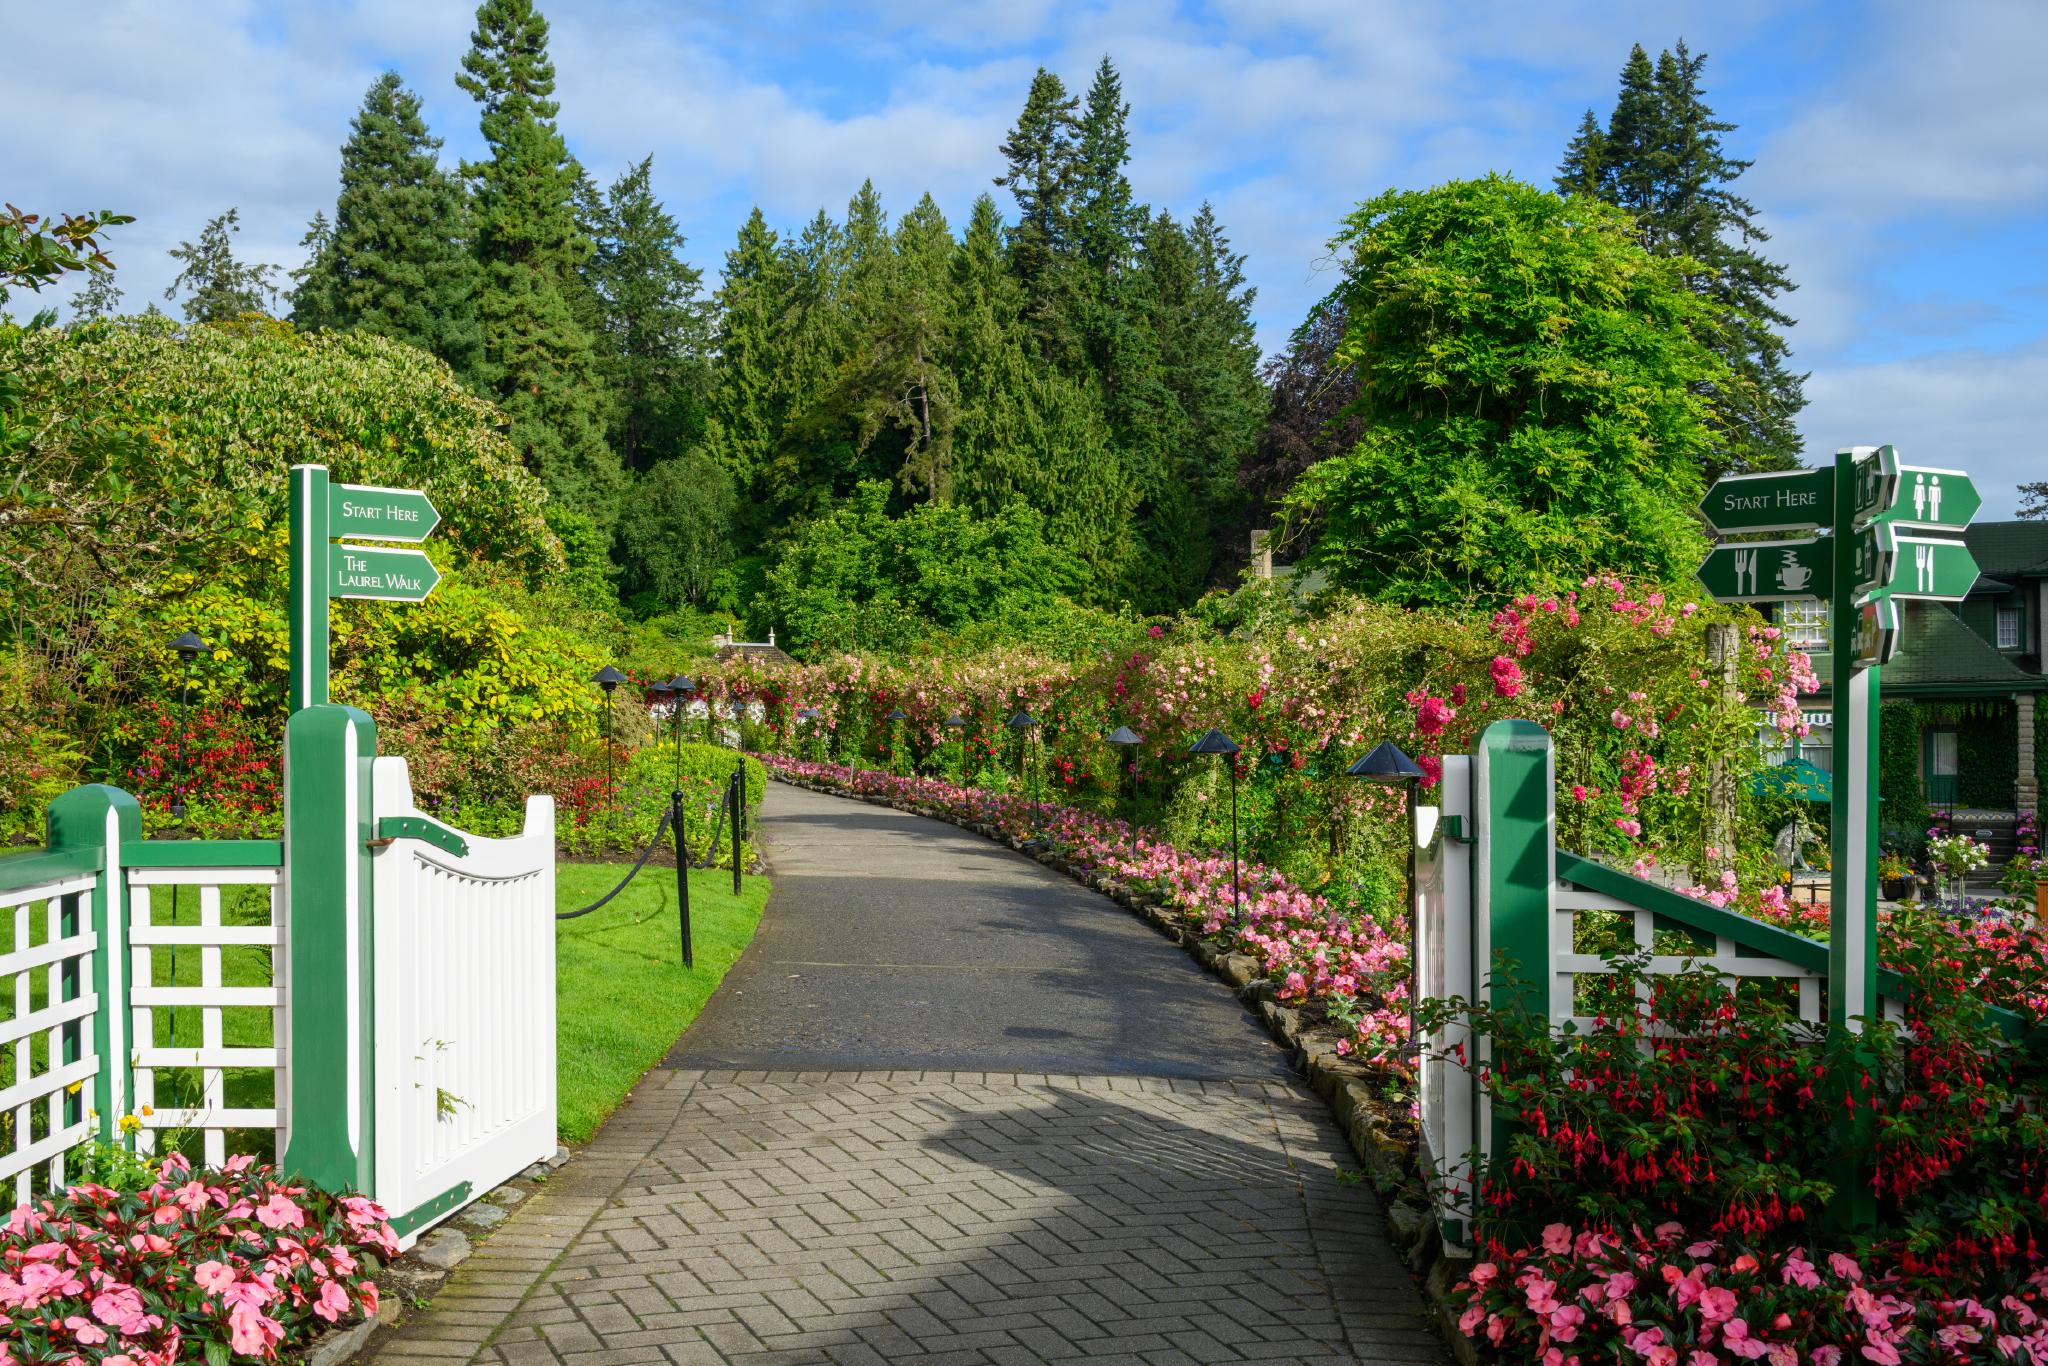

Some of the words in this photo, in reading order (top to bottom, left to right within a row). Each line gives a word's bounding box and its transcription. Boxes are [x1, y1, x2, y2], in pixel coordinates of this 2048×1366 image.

[1724, 494, 1770, 511] START
[1776, 489, 1816, 507] HERE
[343, 501, 382, 519] START
[387, 505, 419, 522] HERE
[343, 555, 367, 572] THE
[338, 570, 384, 588] LAUREL
[385, 573, 421, 590] WALK
